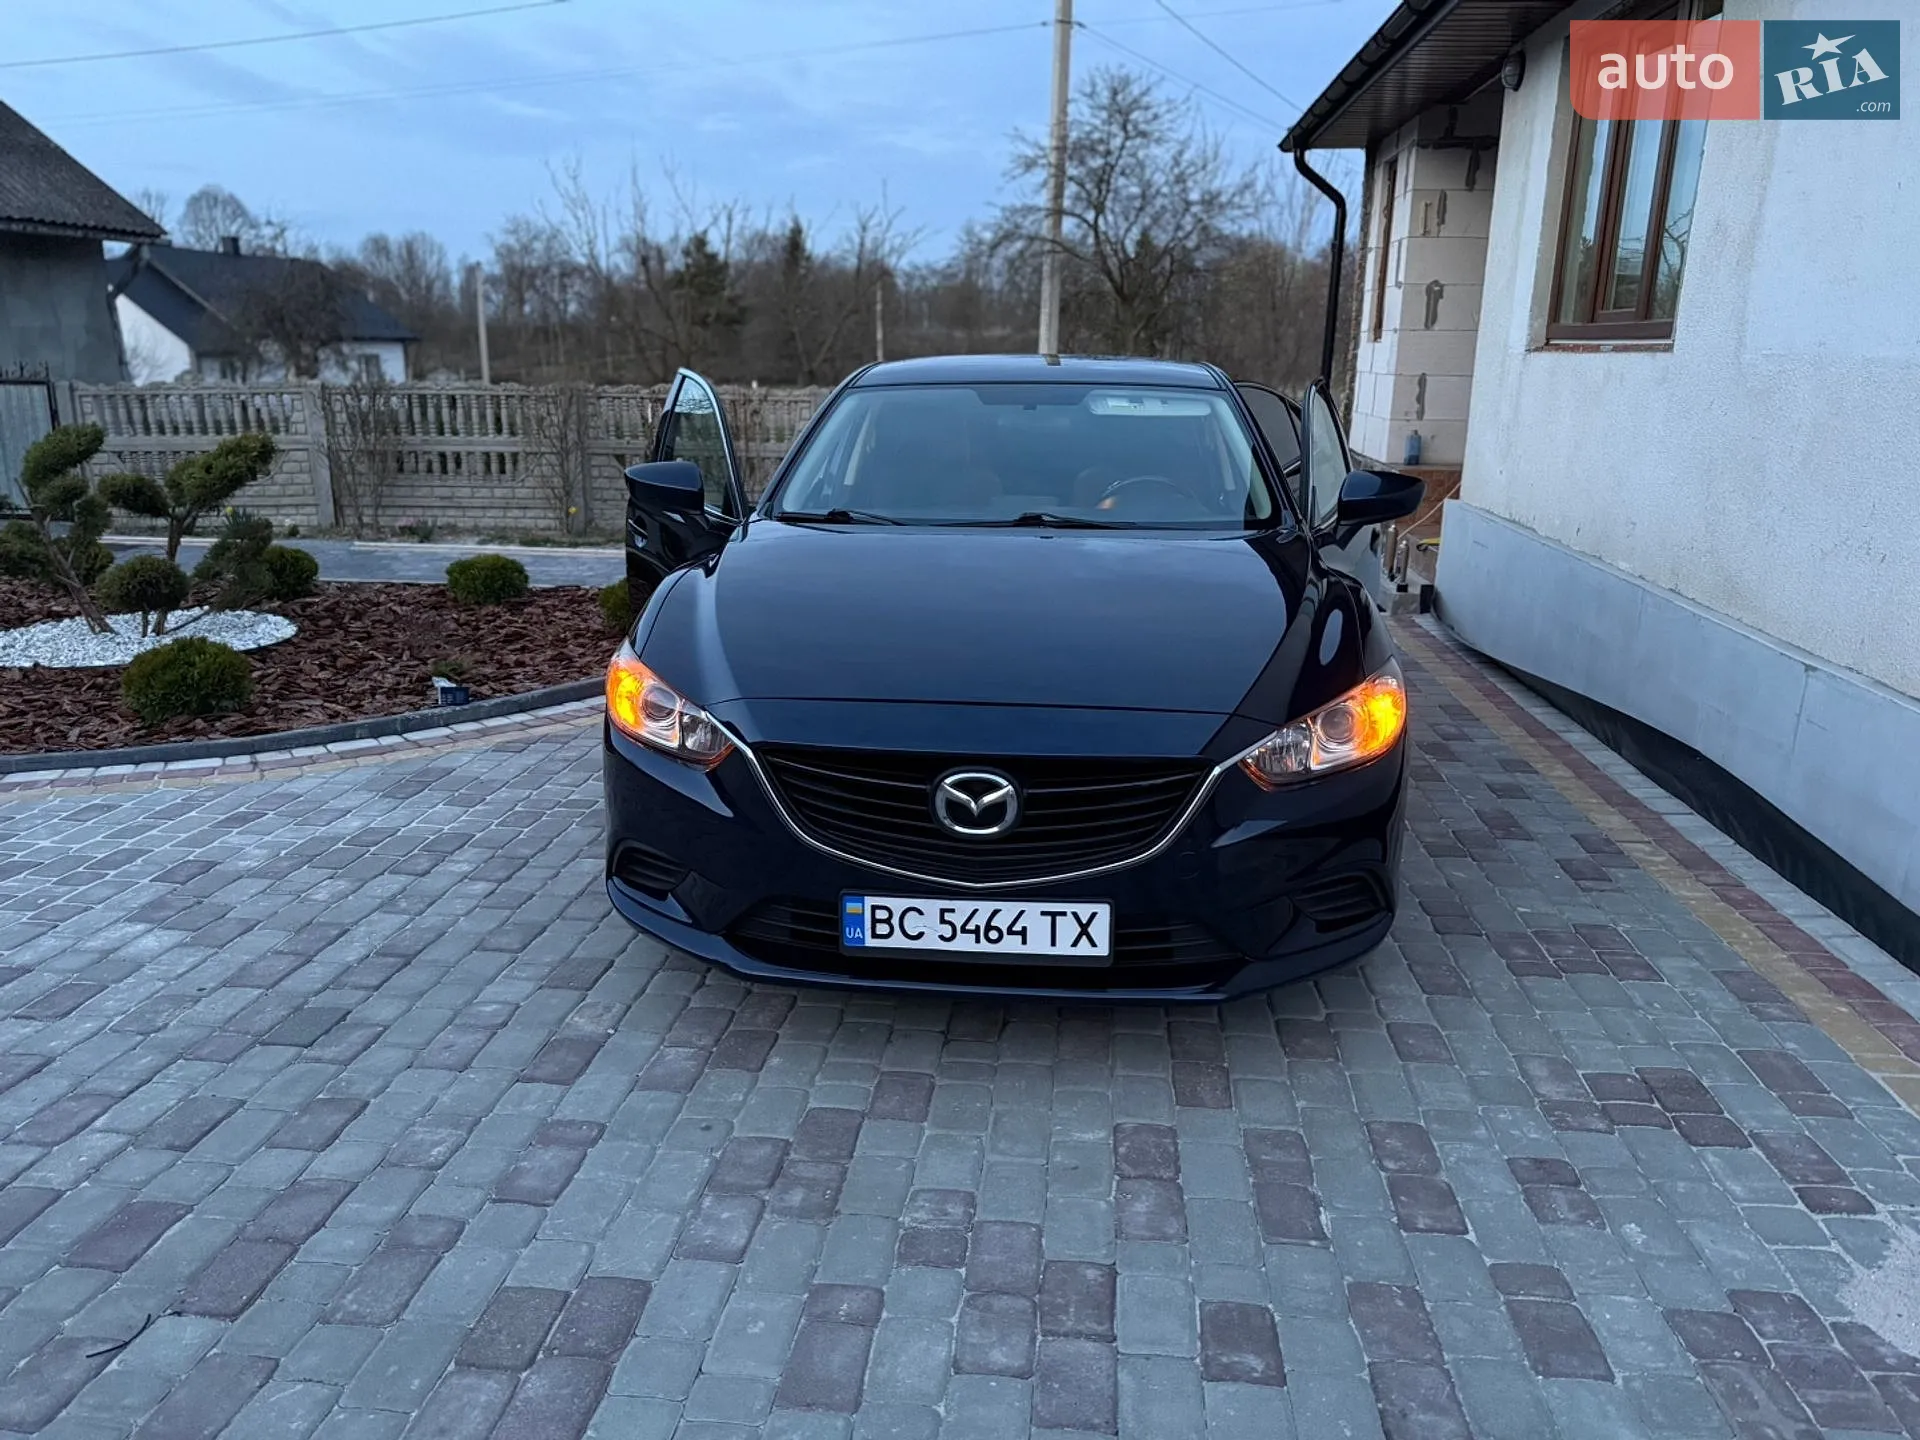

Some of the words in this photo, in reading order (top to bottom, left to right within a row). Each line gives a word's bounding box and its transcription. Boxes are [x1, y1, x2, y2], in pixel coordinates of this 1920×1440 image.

[846, 927, 863, 939] UA
[870, 904, 925, 940] BC
[938, 908, 1028, 945] 5464
[1040, 911, 1098, 947] TX
